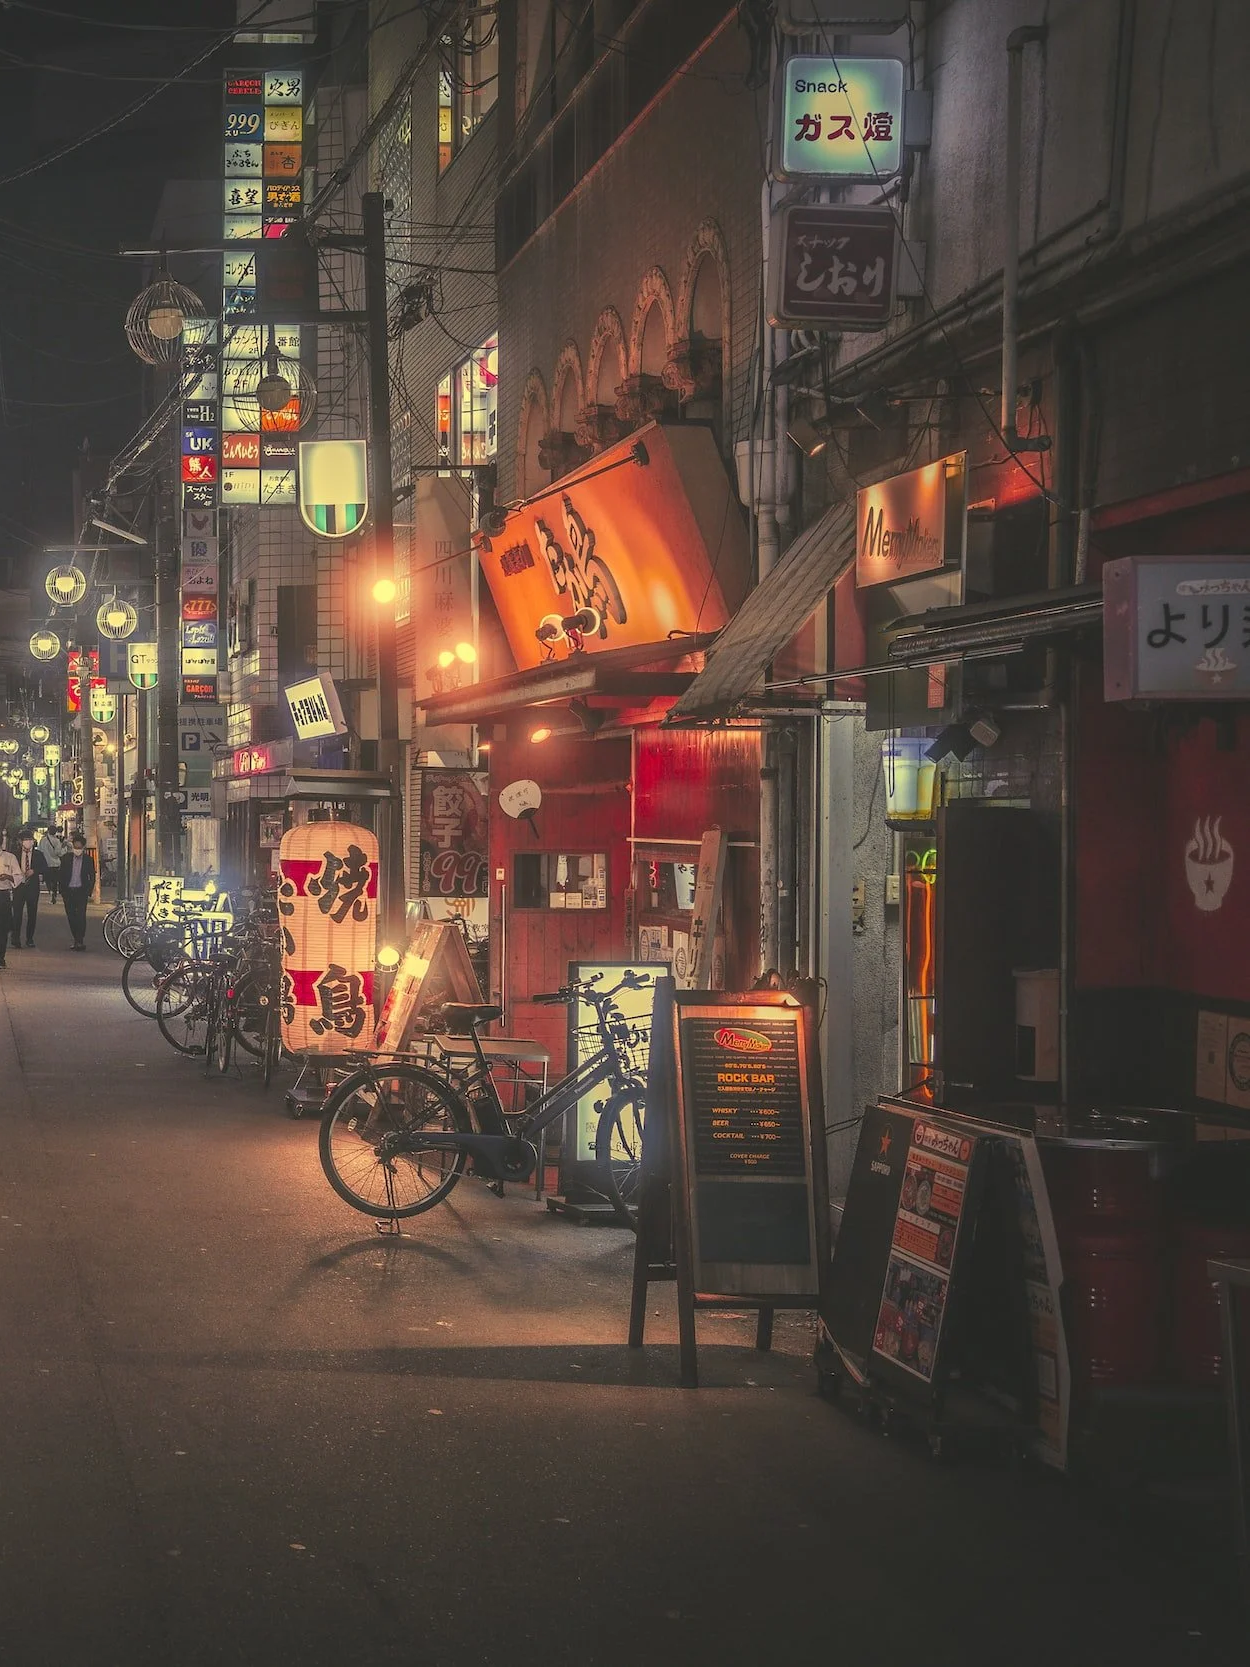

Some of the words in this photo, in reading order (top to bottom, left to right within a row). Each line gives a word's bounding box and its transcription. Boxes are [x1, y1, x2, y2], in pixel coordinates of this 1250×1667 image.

[794, 80, 848, 94] Snack
[227, 113, 261, 135] 999
[794, 112, 894, 142] ガス燈
[797, 234, 850, 249] スナック
[226, 263, 256, 275] コレクショ
[797, 253, 885, 298] しおり
[190, 437, 213, 451] UK
[190, 600, 212, 611] 777
[1147, 602, 1250, 649] より
[191, 792, 211, 801] 光明
[432, 785, 463, 849] 餃子
[307, 844, 370, 1039] 焼鳥
[717, 1073, 749, 1083] ROCK
[751, 1073, 775, 1083] BAR
